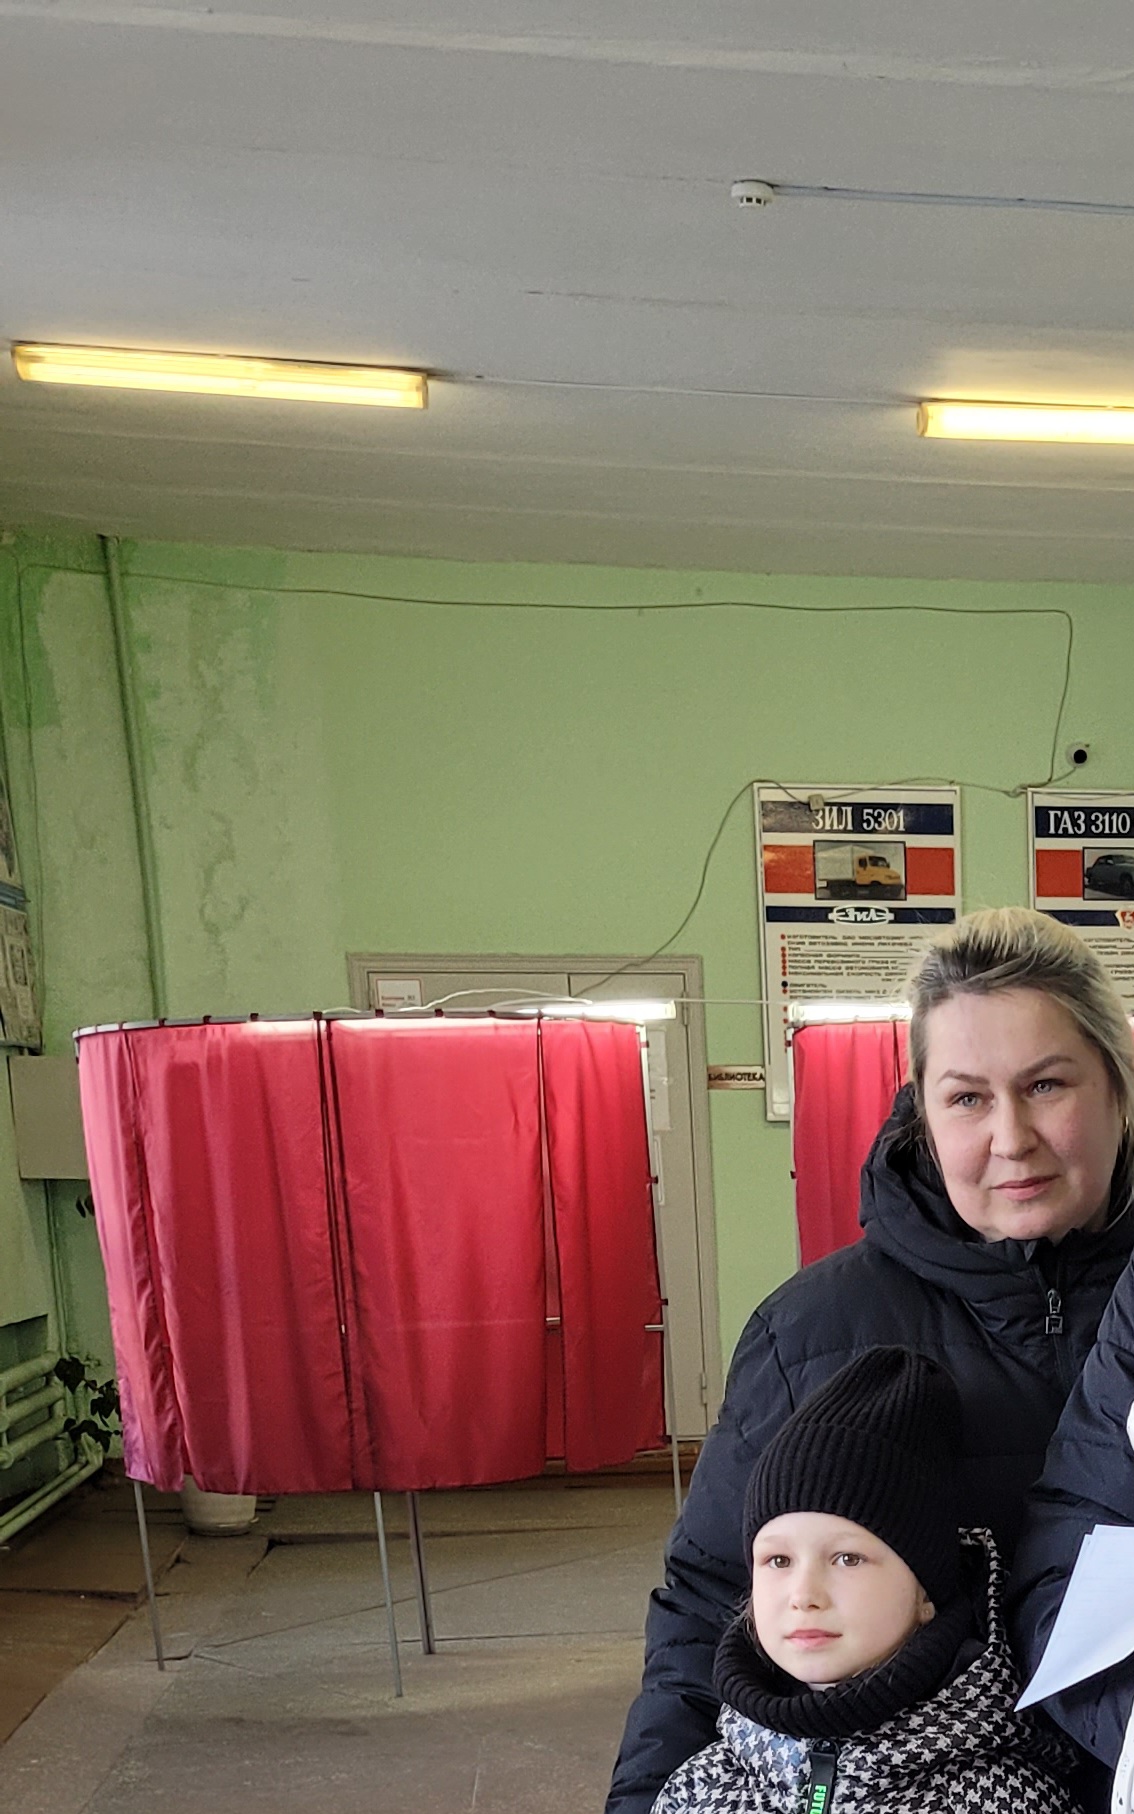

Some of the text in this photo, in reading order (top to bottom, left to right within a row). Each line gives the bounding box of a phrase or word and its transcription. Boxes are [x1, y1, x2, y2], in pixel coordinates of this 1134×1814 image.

[811, 805, 906, 832] ЗИЛ 5301
[1048, 810, 1086, 835] ГАЗ
[1091, 812, 1131, 834] 3110
